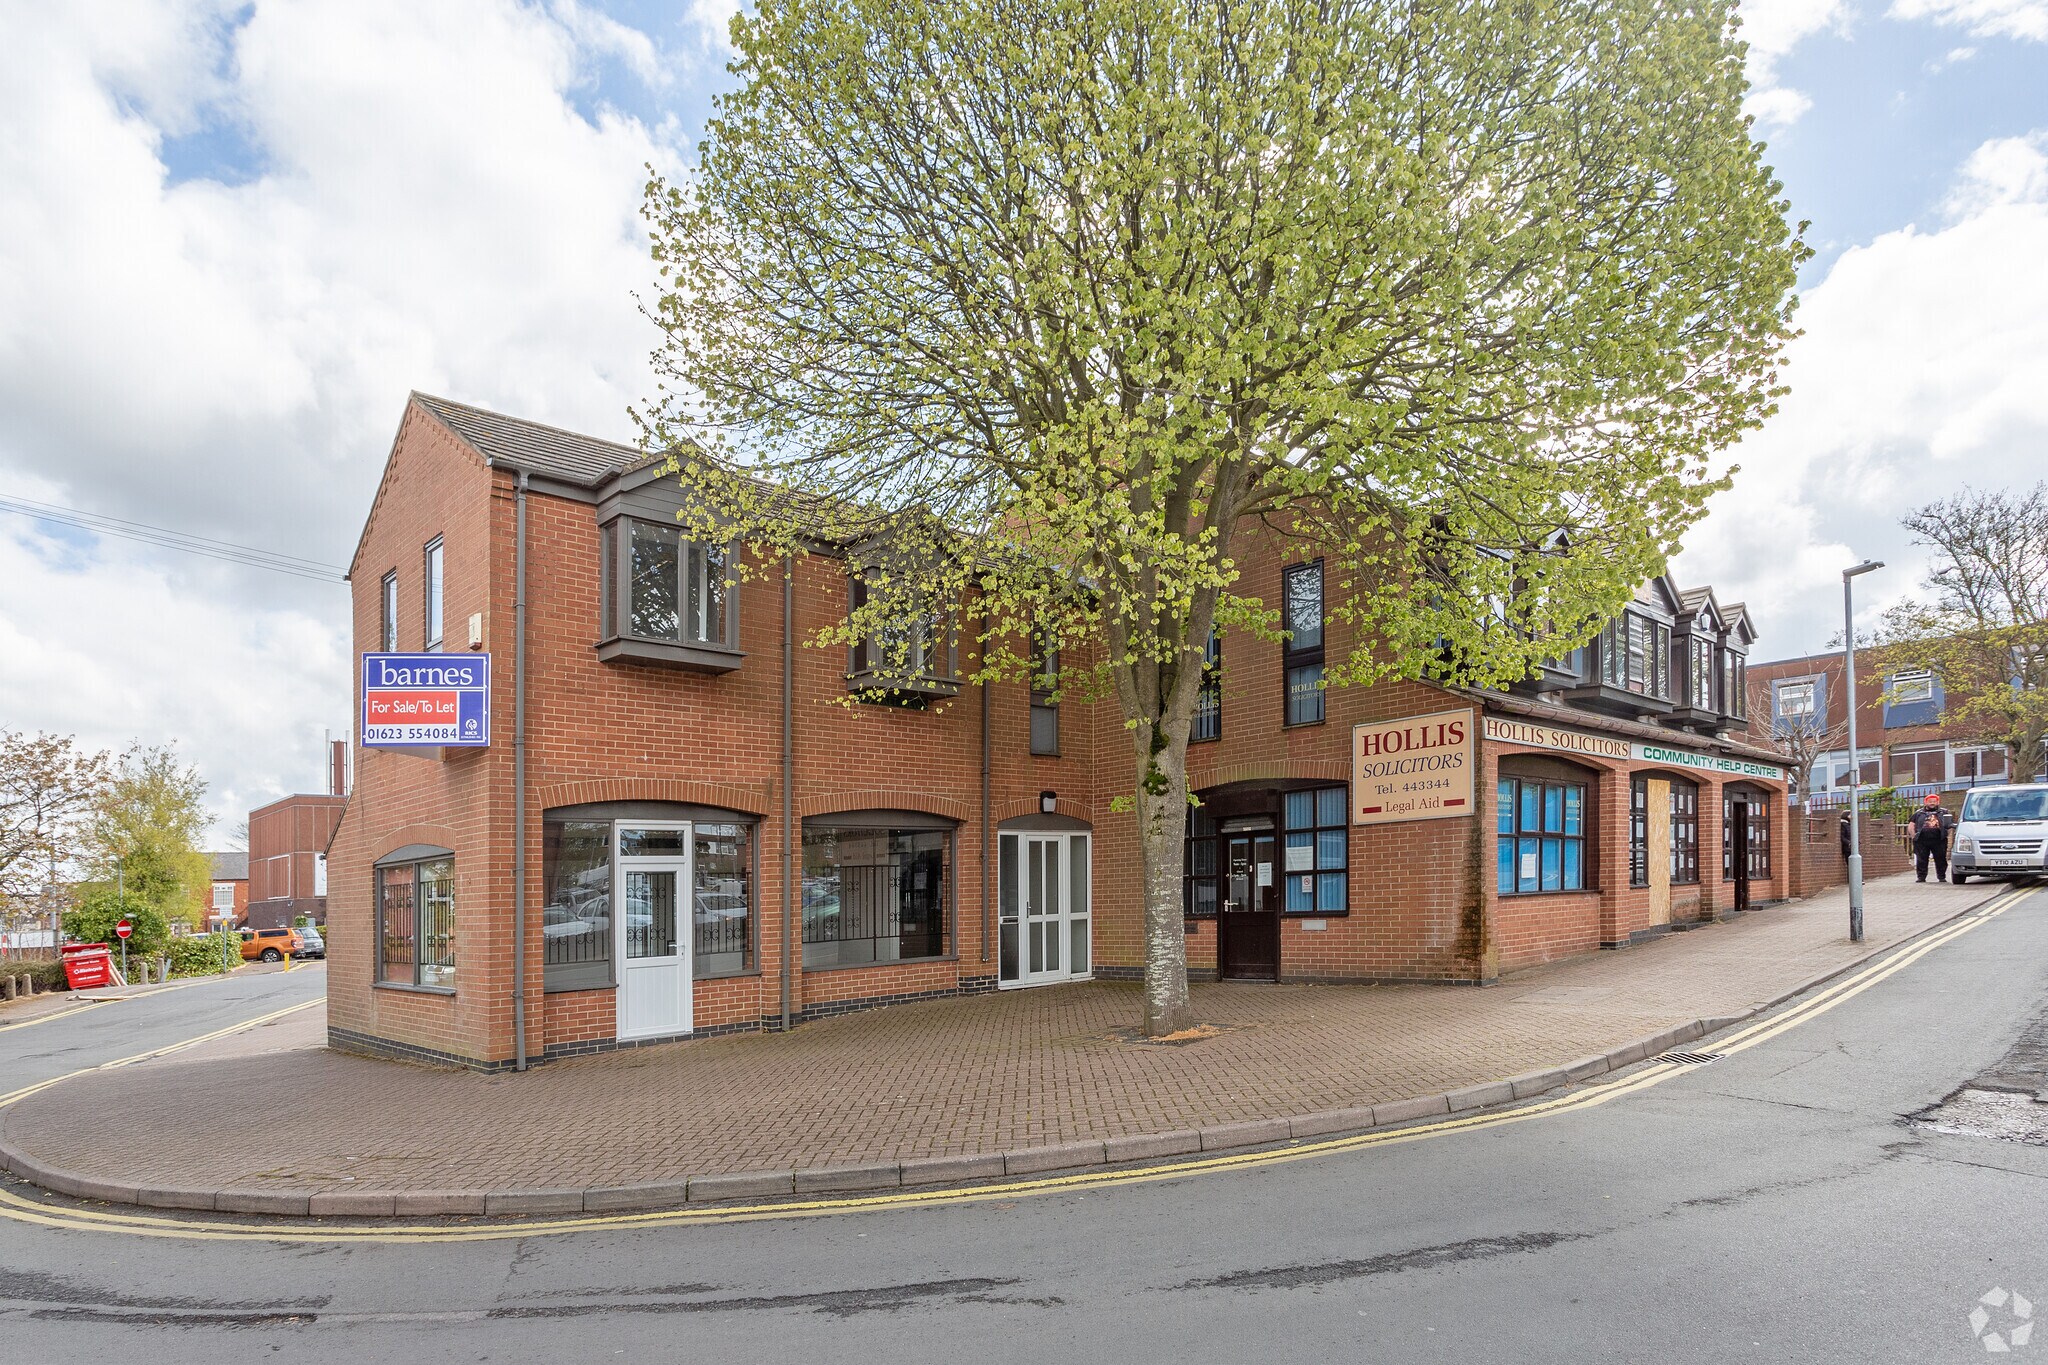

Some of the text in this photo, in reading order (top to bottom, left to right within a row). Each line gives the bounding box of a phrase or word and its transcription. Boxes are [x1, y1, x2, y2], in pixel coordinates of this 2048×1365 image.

[379, 660, 473, 686] barnes
[1291, 682, 1318, 693] HOLLI
[371, 700, 455, 715] For Sale/To Let
[368, 728, 457, 739] 01623 554084
[1362, 721, 1465, 757] HOLLIS
[1486, 720, 1629, 757] HOLLIS SOLICITORS
[1362, 752, 1463, 779] SOLICITORS
[1643, 747, 1777, 778] COMMUNITY HELP CENTRE
[1375, 779, 1450, 795] Tel. 443344
[1385, 796, 1440, 814] Legal Aid
